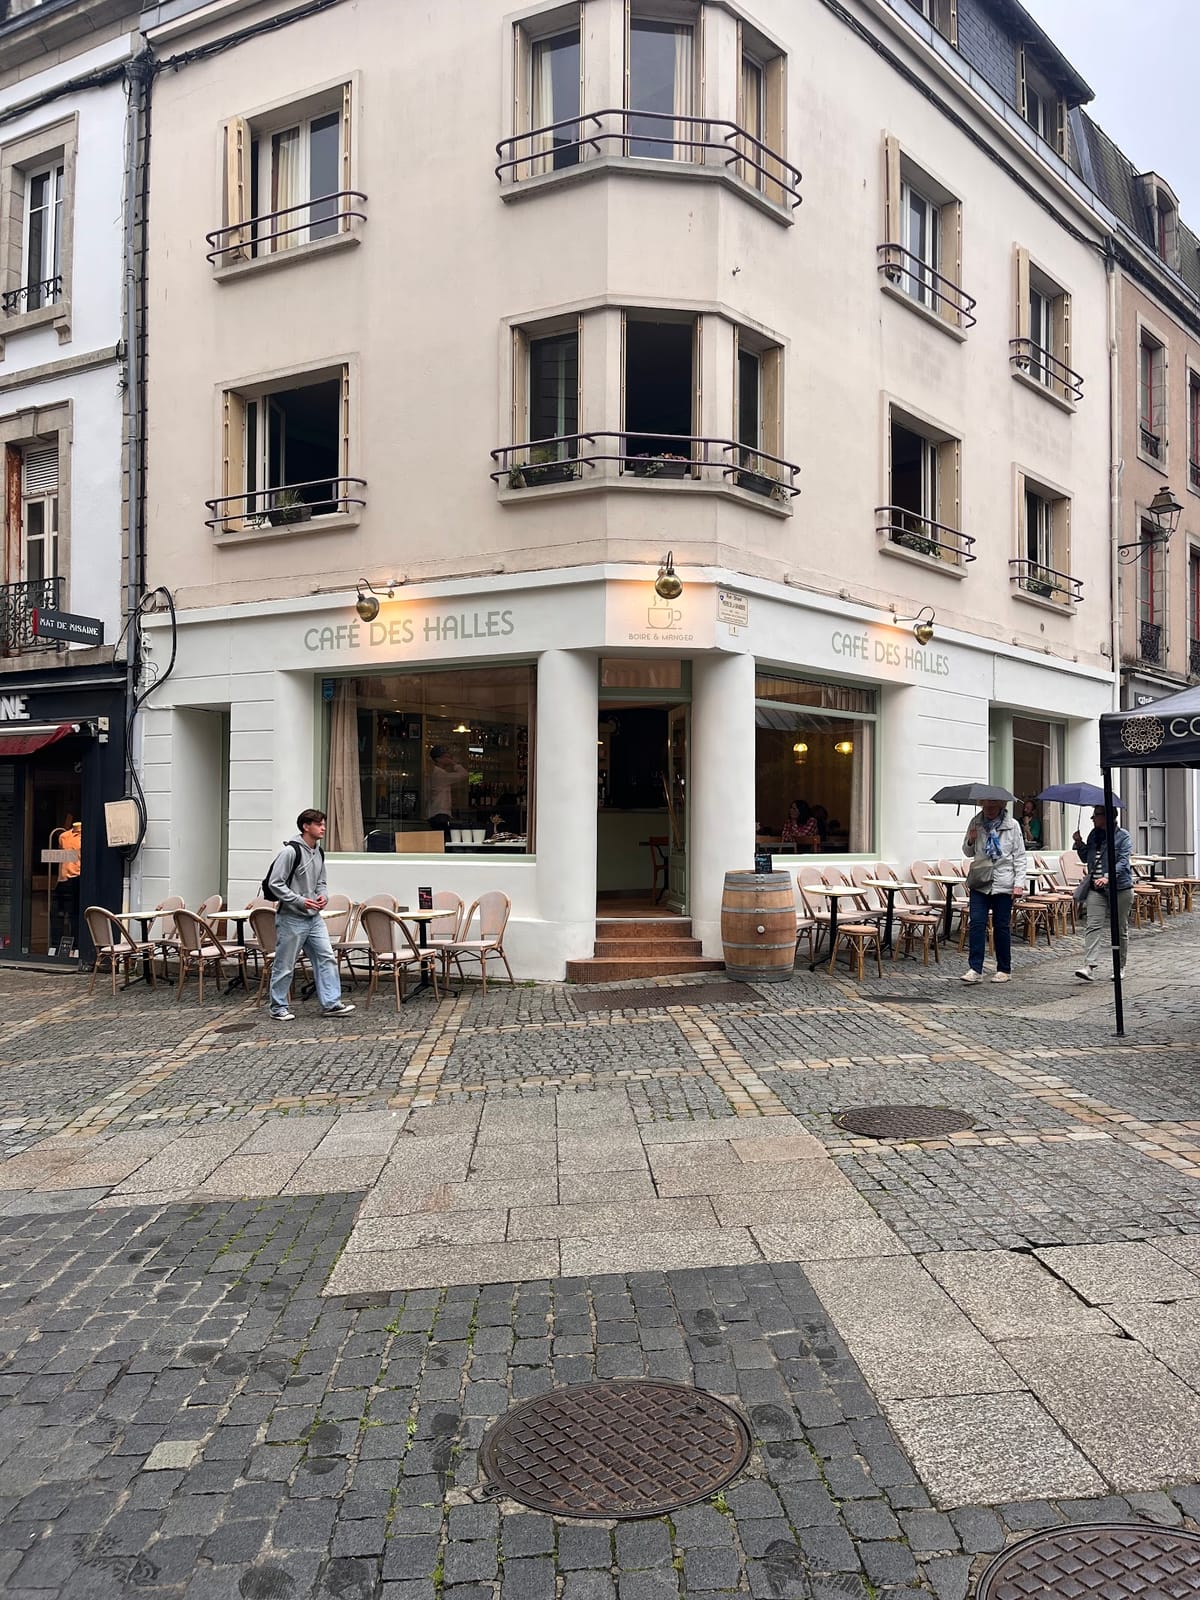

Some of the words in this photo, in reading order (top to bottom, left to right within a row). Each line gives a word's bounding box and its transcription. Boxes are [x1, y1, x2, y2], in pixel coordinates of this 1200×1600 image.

[56, 621, 68, 630] DE
[69, 623, 99, 636] MISAINE
[304, 619, 360, 651] CAFÉ
[369, 619, 414, 647] DES
[423, 610, 515, 642] HALLES
[628, 633, 651, 641] BOIRE
[653, 633, 659, 641] &
[661, 634, 694, 642] MANGER
[831, 631, 869, 660] CAFÉ
[874, 640, 901, 666] DES
[904, 647, 950, 676] HALLES
